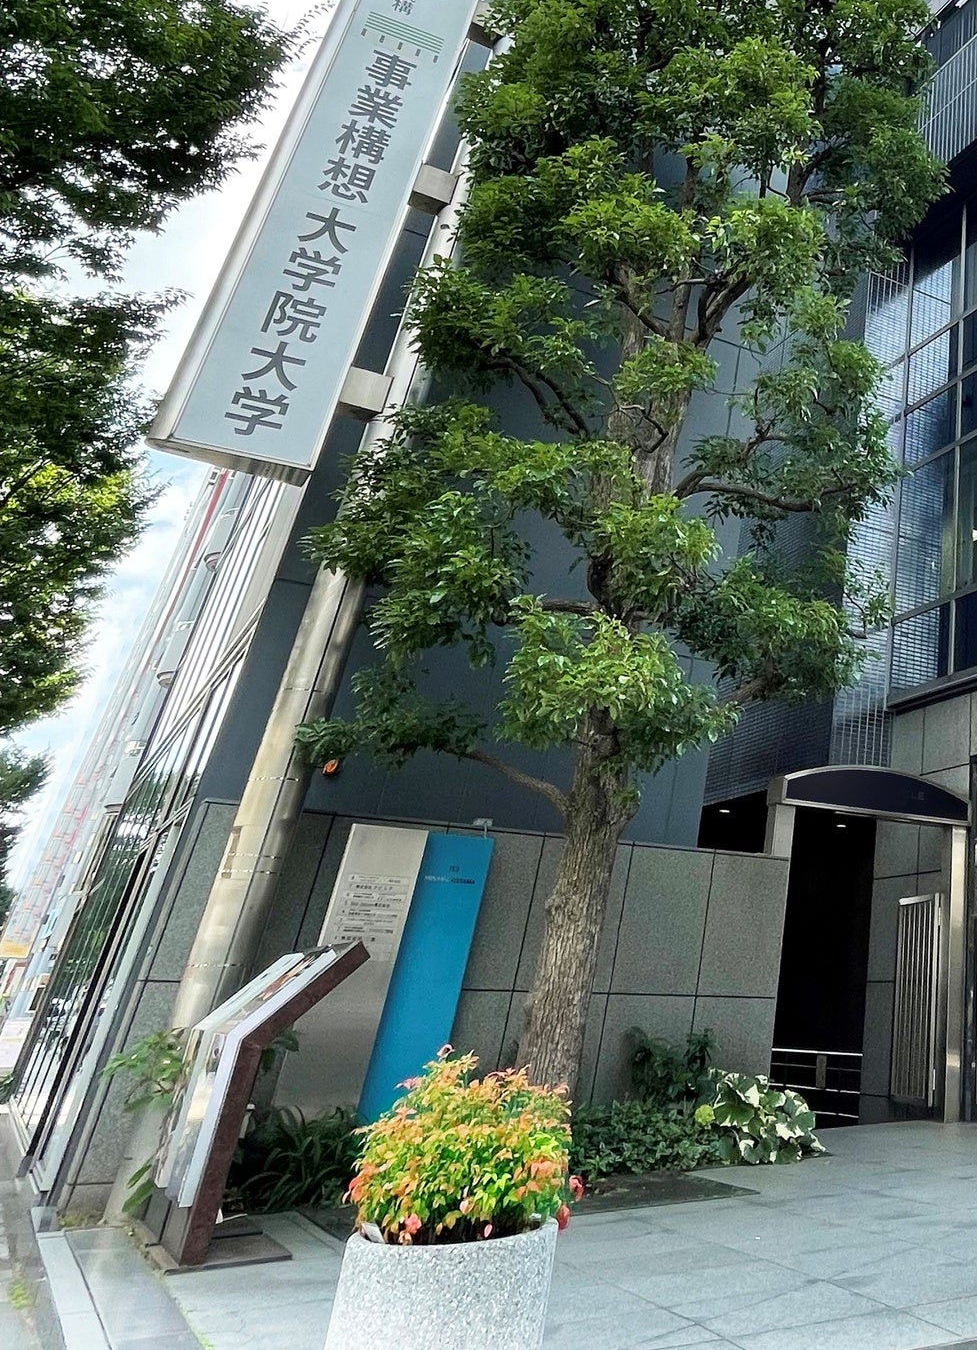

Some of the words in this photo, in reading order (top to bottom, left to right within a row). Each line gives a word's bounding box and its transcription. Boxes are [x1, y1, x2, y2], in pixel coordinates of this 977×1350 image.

[224, 49, 417, 436] 事業構想大学院大学
